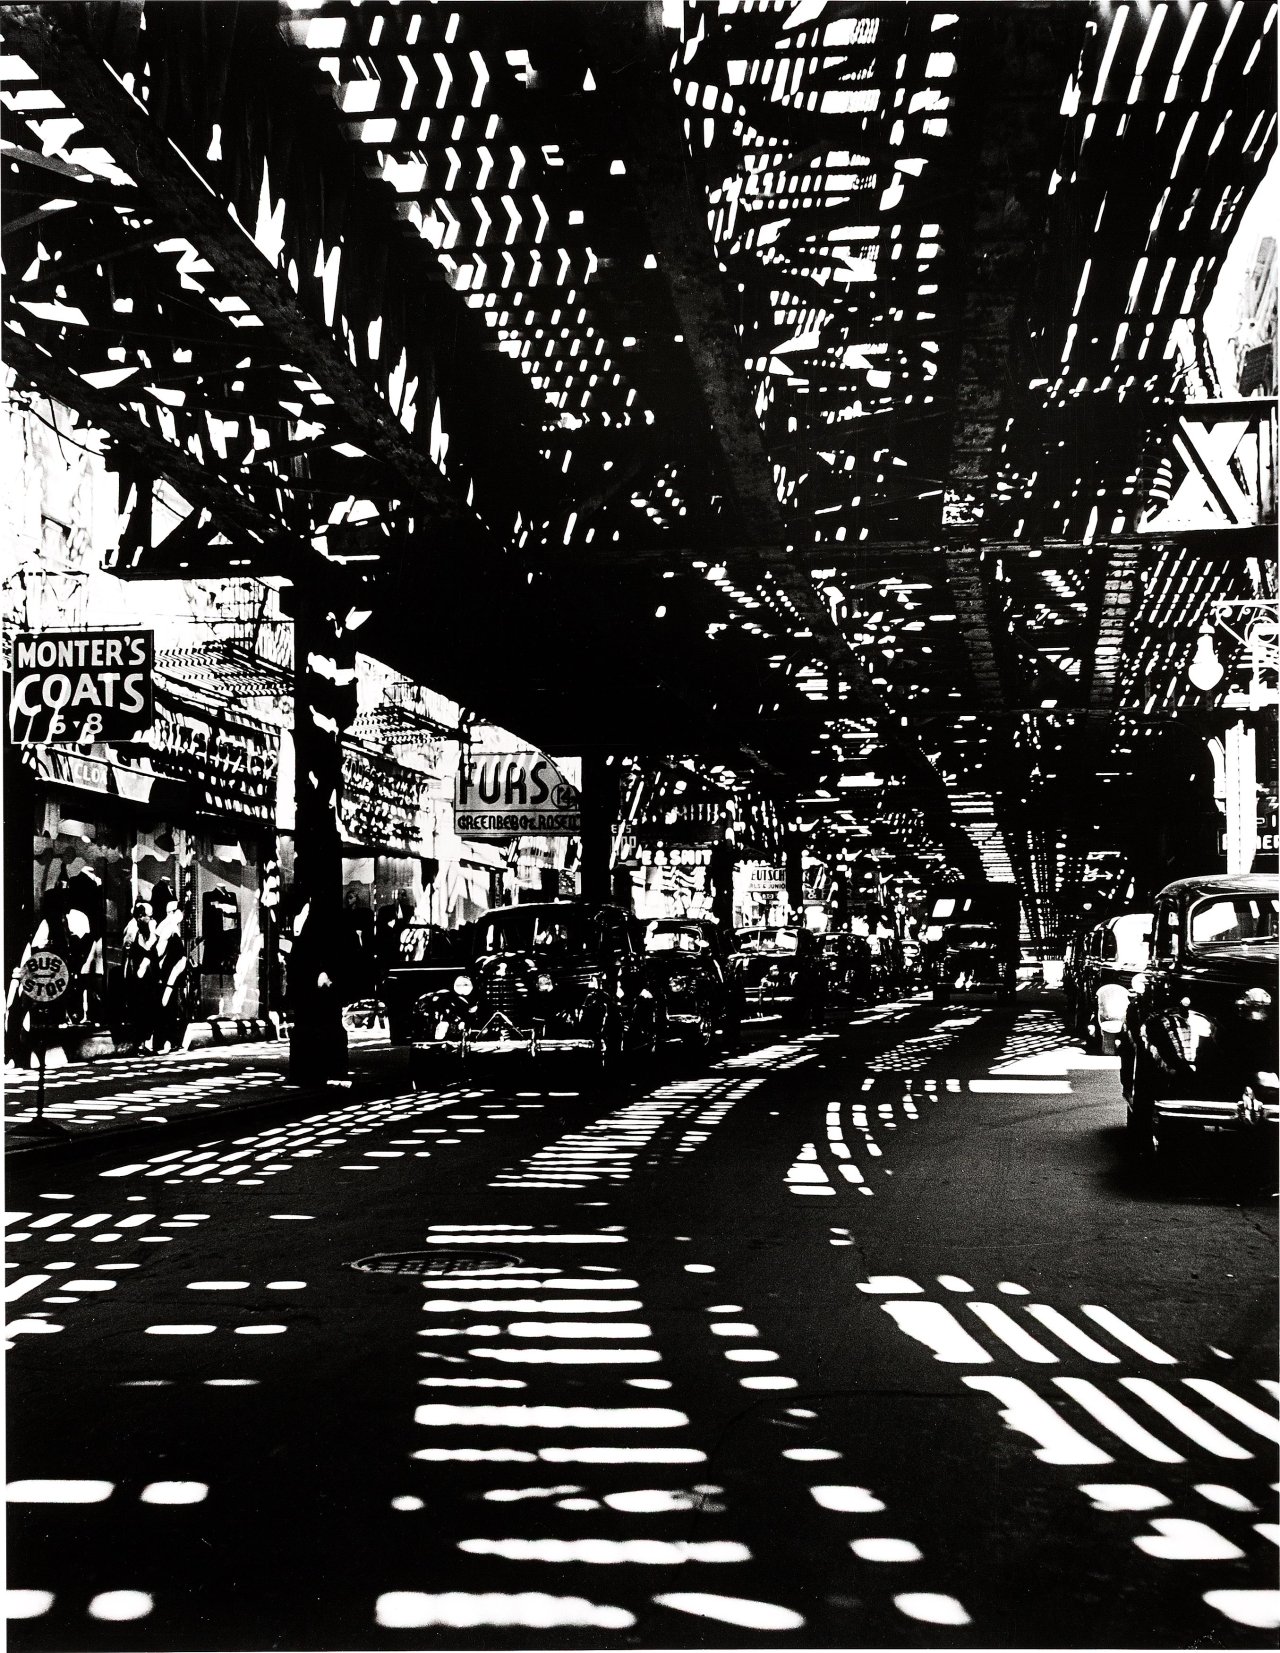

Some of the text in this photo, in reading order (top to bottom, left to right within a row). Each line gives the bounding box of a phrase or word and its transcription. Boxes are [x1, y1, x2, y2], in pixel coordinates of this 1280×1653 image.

[18, 635, 146, 669] MONTER'S
[15, 672, 145, 716] COATS
[458, 760, 549, 805] FURS
[26, 957, 62, 973] BUS
[23, 978, 66, 997] STOP
